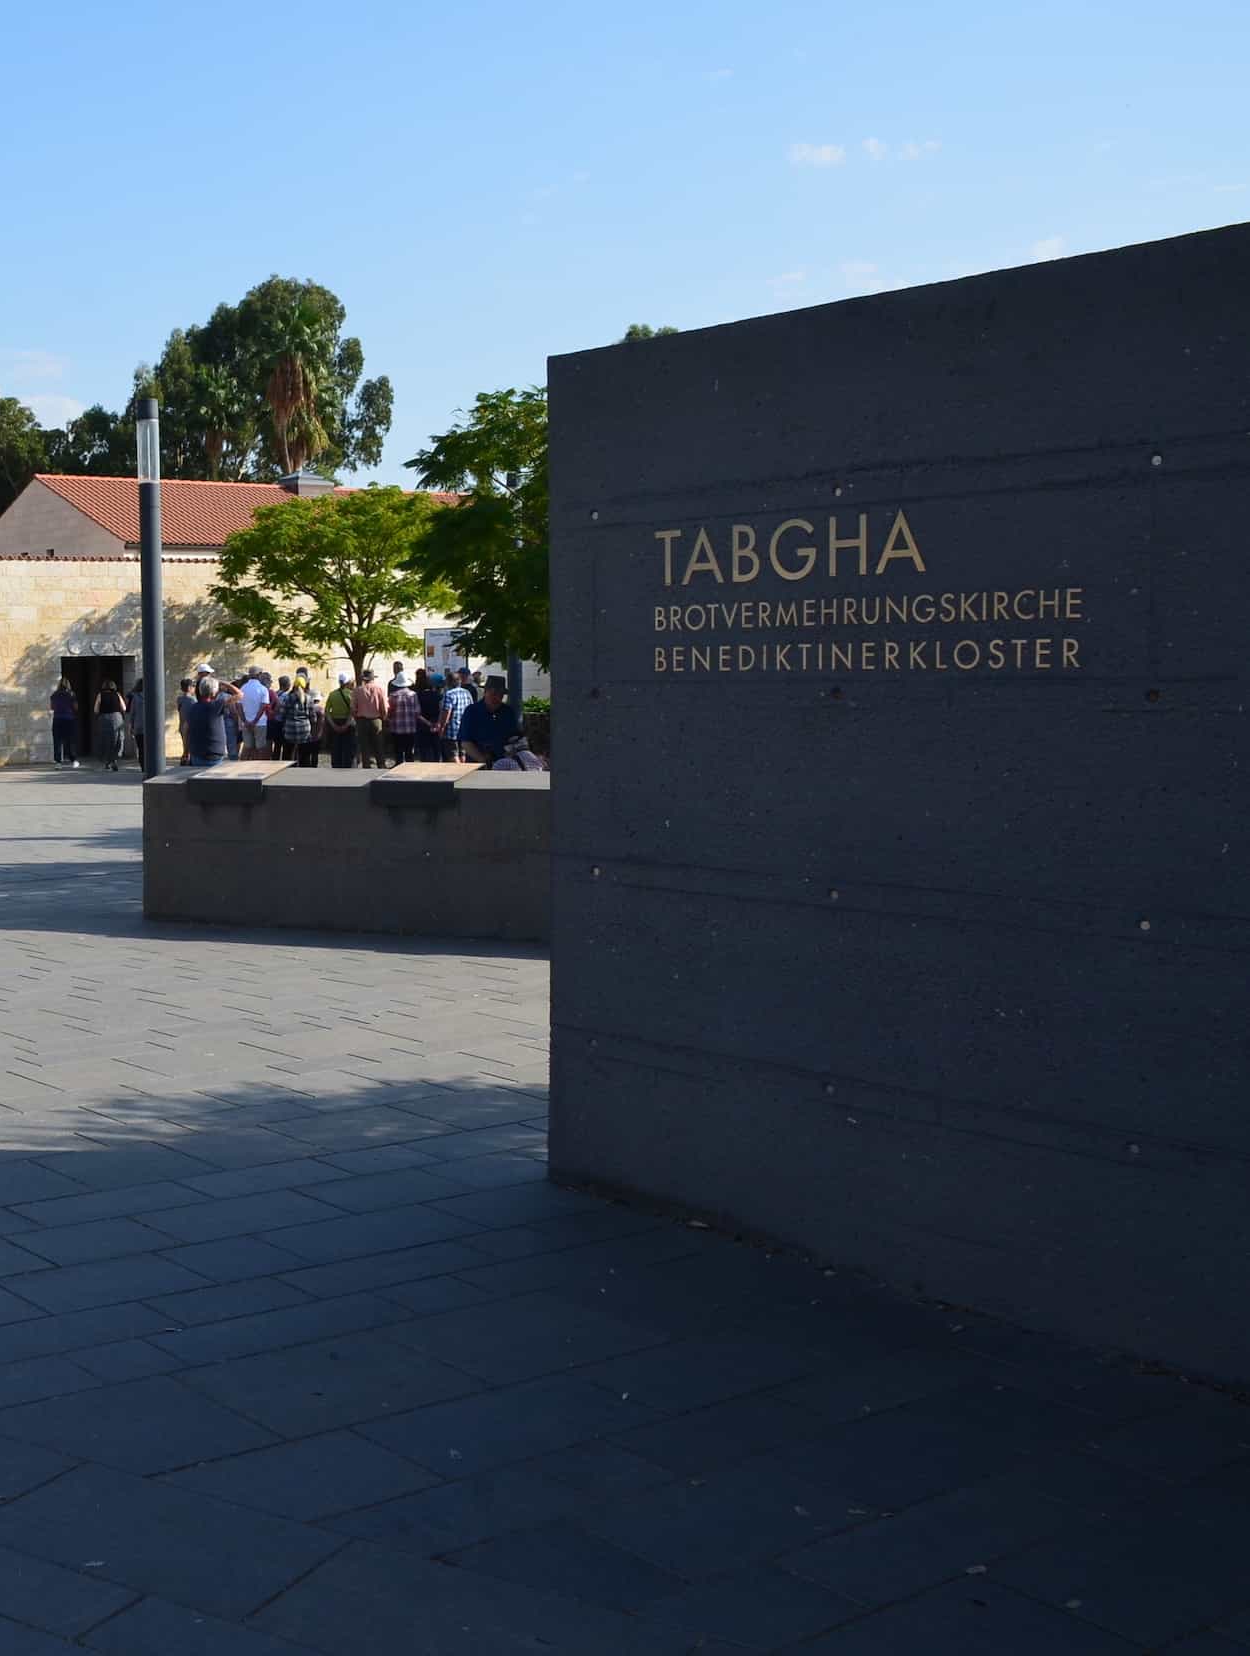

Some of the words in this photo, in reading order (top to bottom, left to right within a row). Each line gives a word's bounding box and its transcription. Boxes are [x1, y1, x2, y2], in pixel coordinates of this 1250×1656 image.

[654, 509, 926, 586] TABGHA
[654, 589, 1084, 631] BROTVERMEHRUNGSKIRCHE
[654, 638, 1081, 672] BENEDIKTINERKLOSTER
